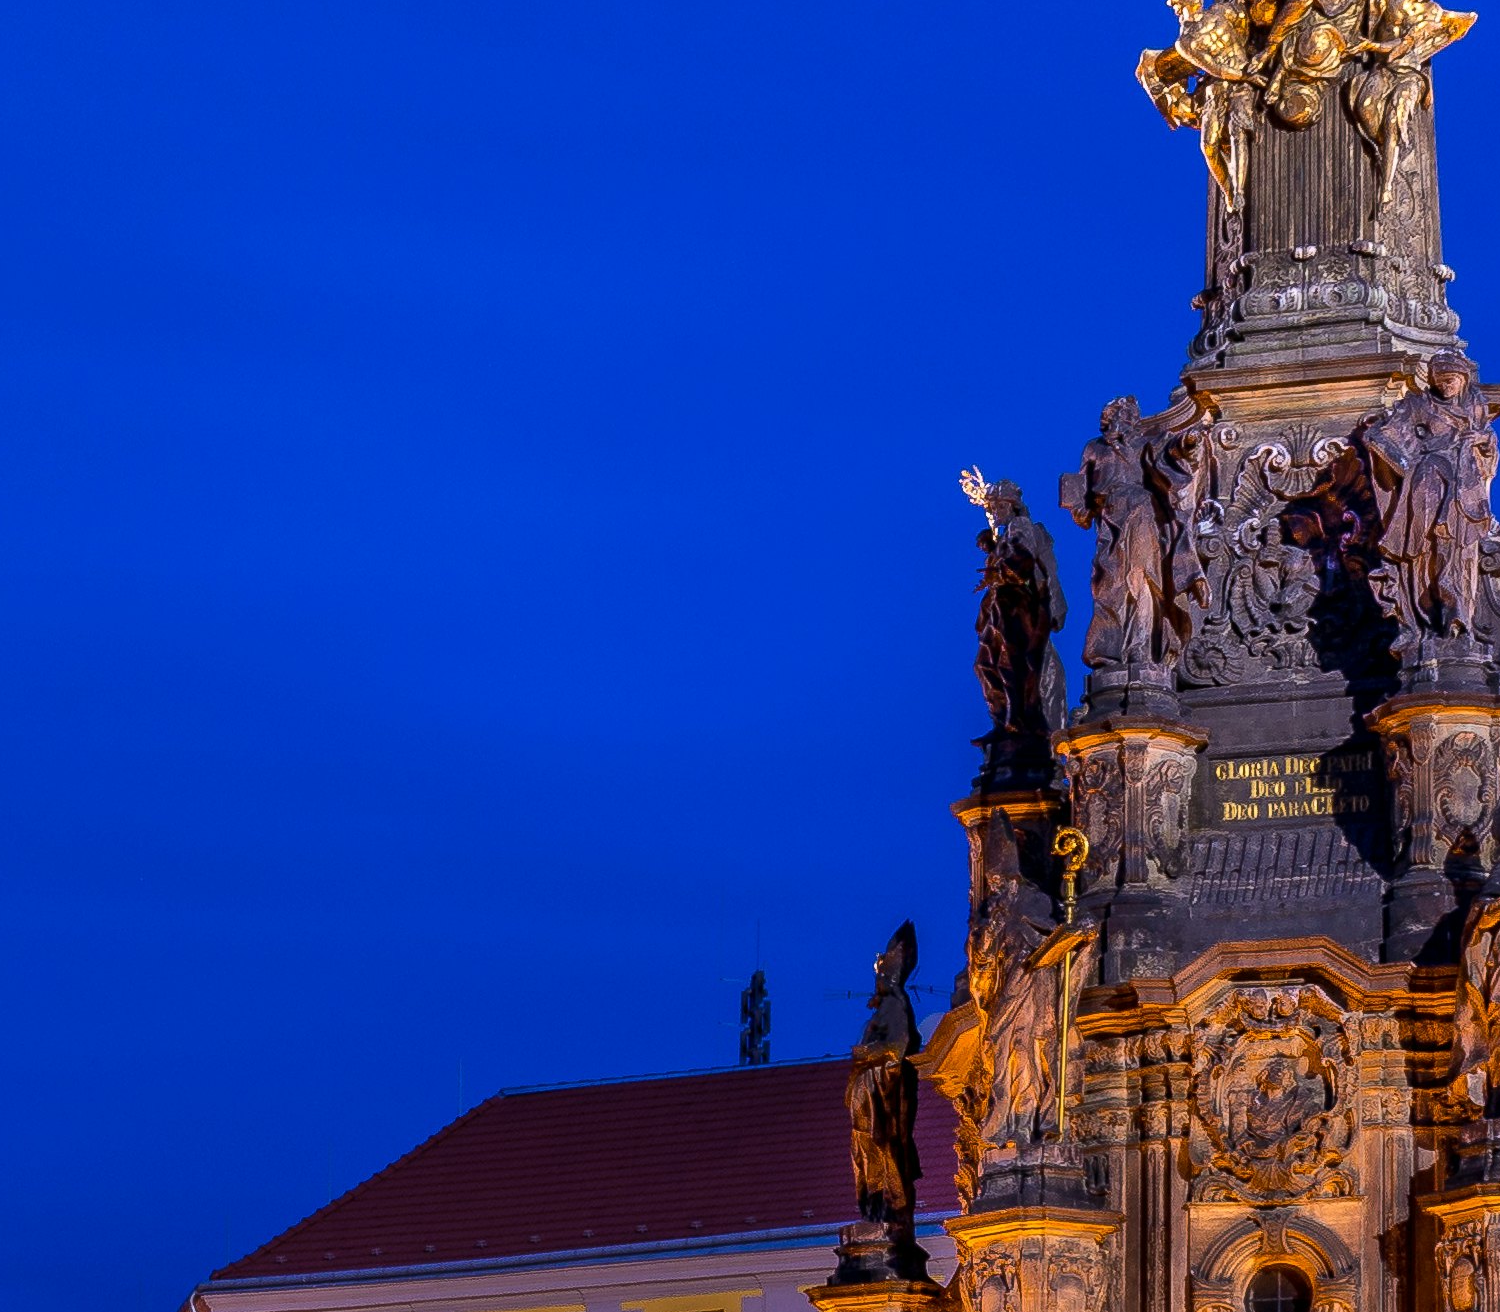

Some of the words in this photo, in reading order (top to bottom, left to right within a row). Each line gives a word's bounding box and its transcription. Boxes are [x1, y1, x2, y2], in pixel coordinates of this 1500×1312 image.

[1216, 758, 1279, 781] GLORIA
[1251, 779, 1286, 798] DEO
[1223, 801, 1259, 822] DEO
